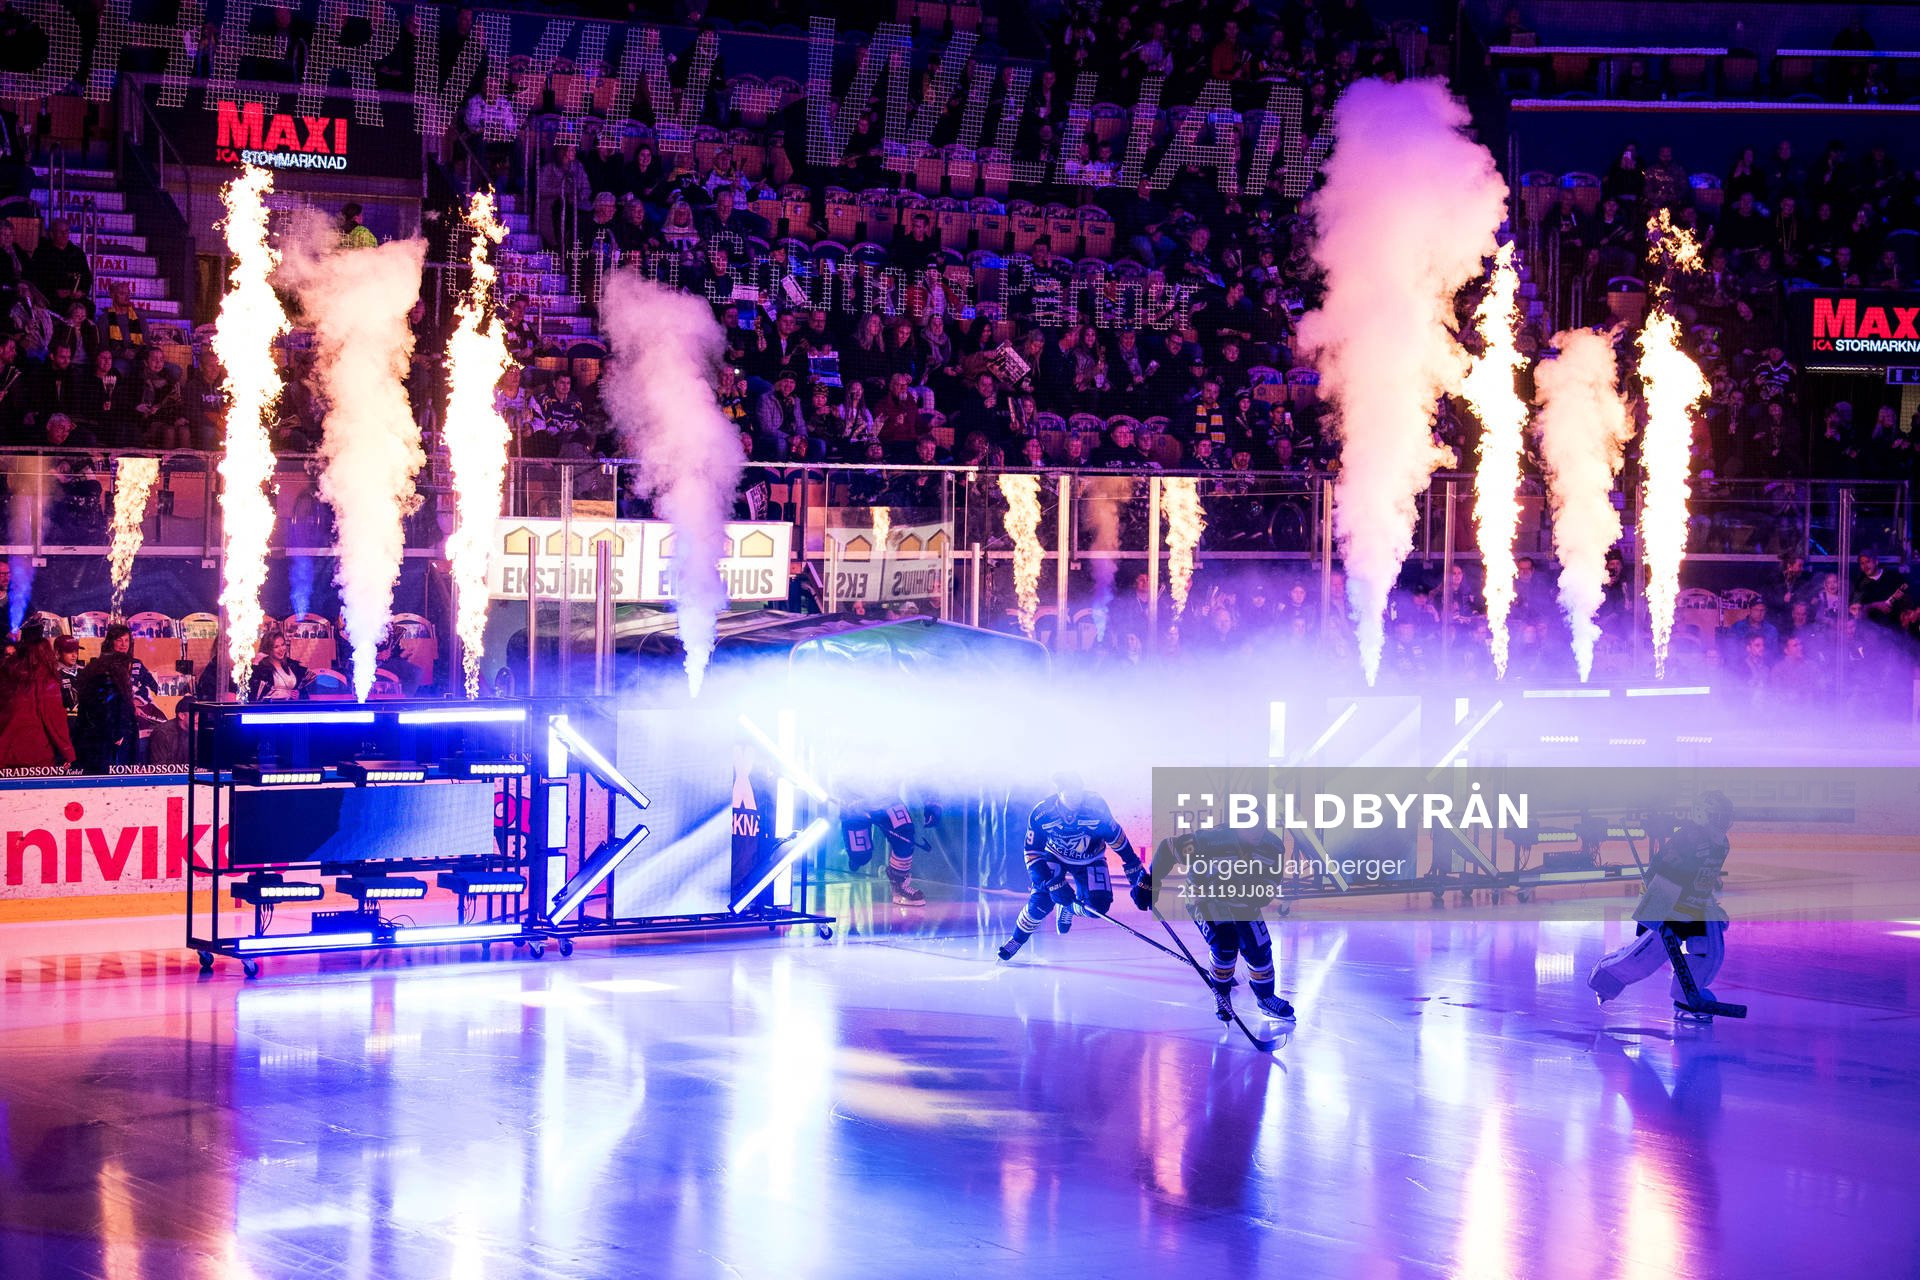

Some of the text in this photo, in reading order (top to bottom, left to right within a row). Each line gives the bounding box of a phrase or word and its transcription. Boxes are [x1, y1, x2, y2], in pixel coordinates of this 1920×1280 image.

[216, 100, 348, 155] MAXI
[241, 150, 347, 170] STORMARKNAD
[1812, 339, 1834, 352] ICA
[502, 563, 624, 596] EKSJÖHS
[109, 763, 190, 775] KONRADSSONS
